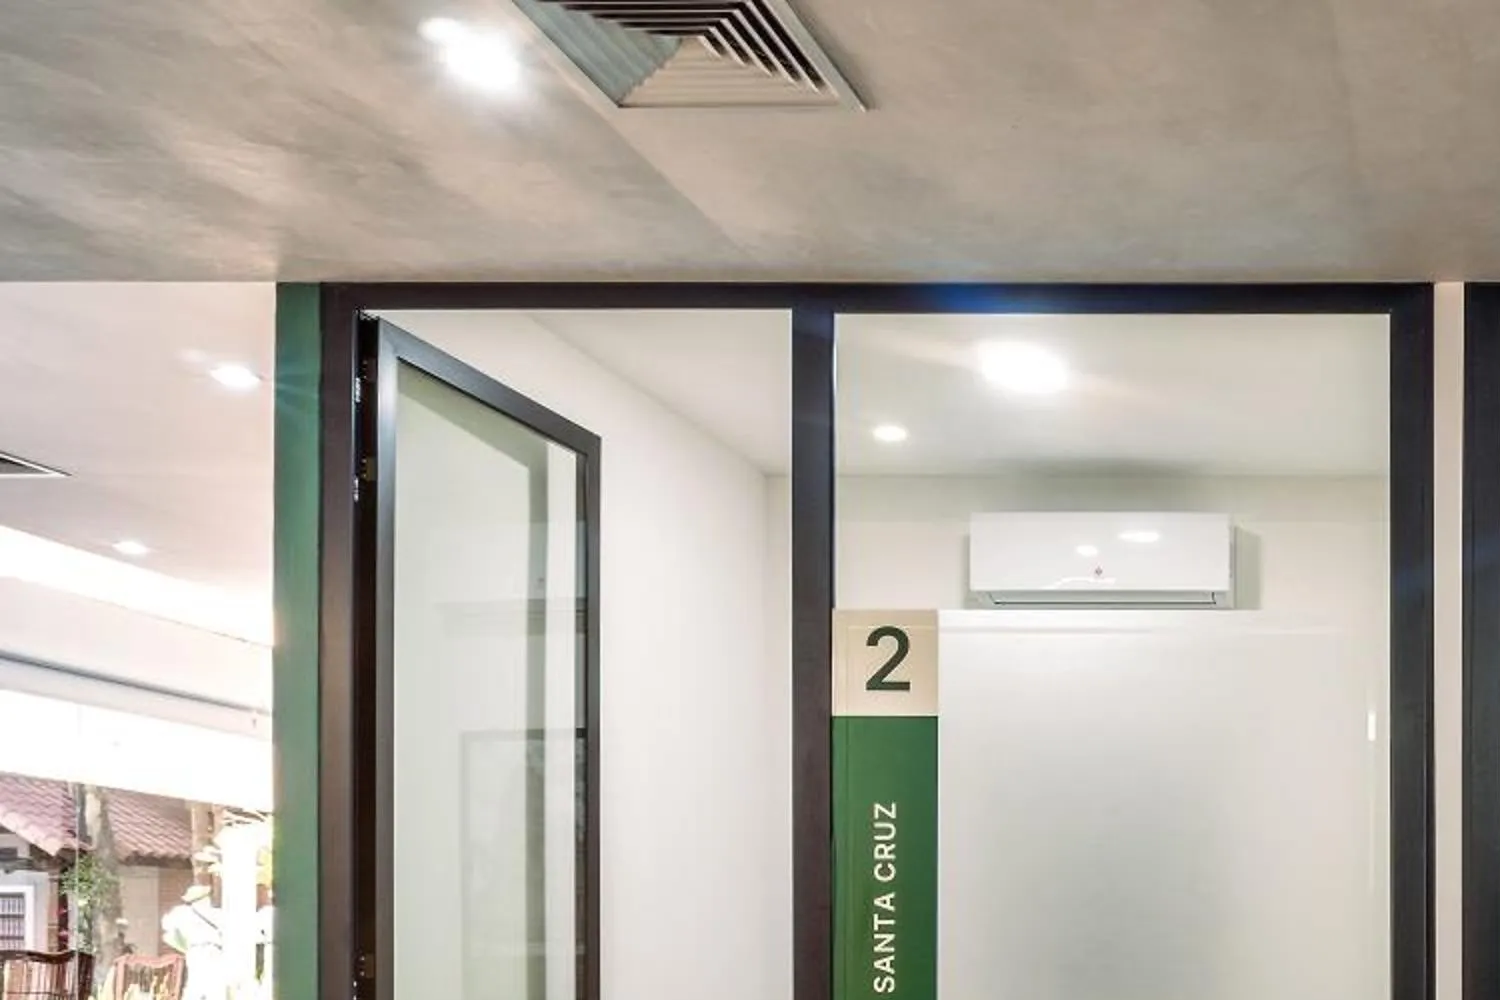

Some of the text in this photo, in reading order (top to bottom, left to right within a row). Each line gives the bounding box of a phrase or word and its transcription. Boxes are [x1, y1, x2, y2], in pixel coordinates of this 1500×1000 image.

[865, 626, 911, 691] 2
[873, 801, 897, 883] CRUZ
[873, 891, 896, 993] SANTA
